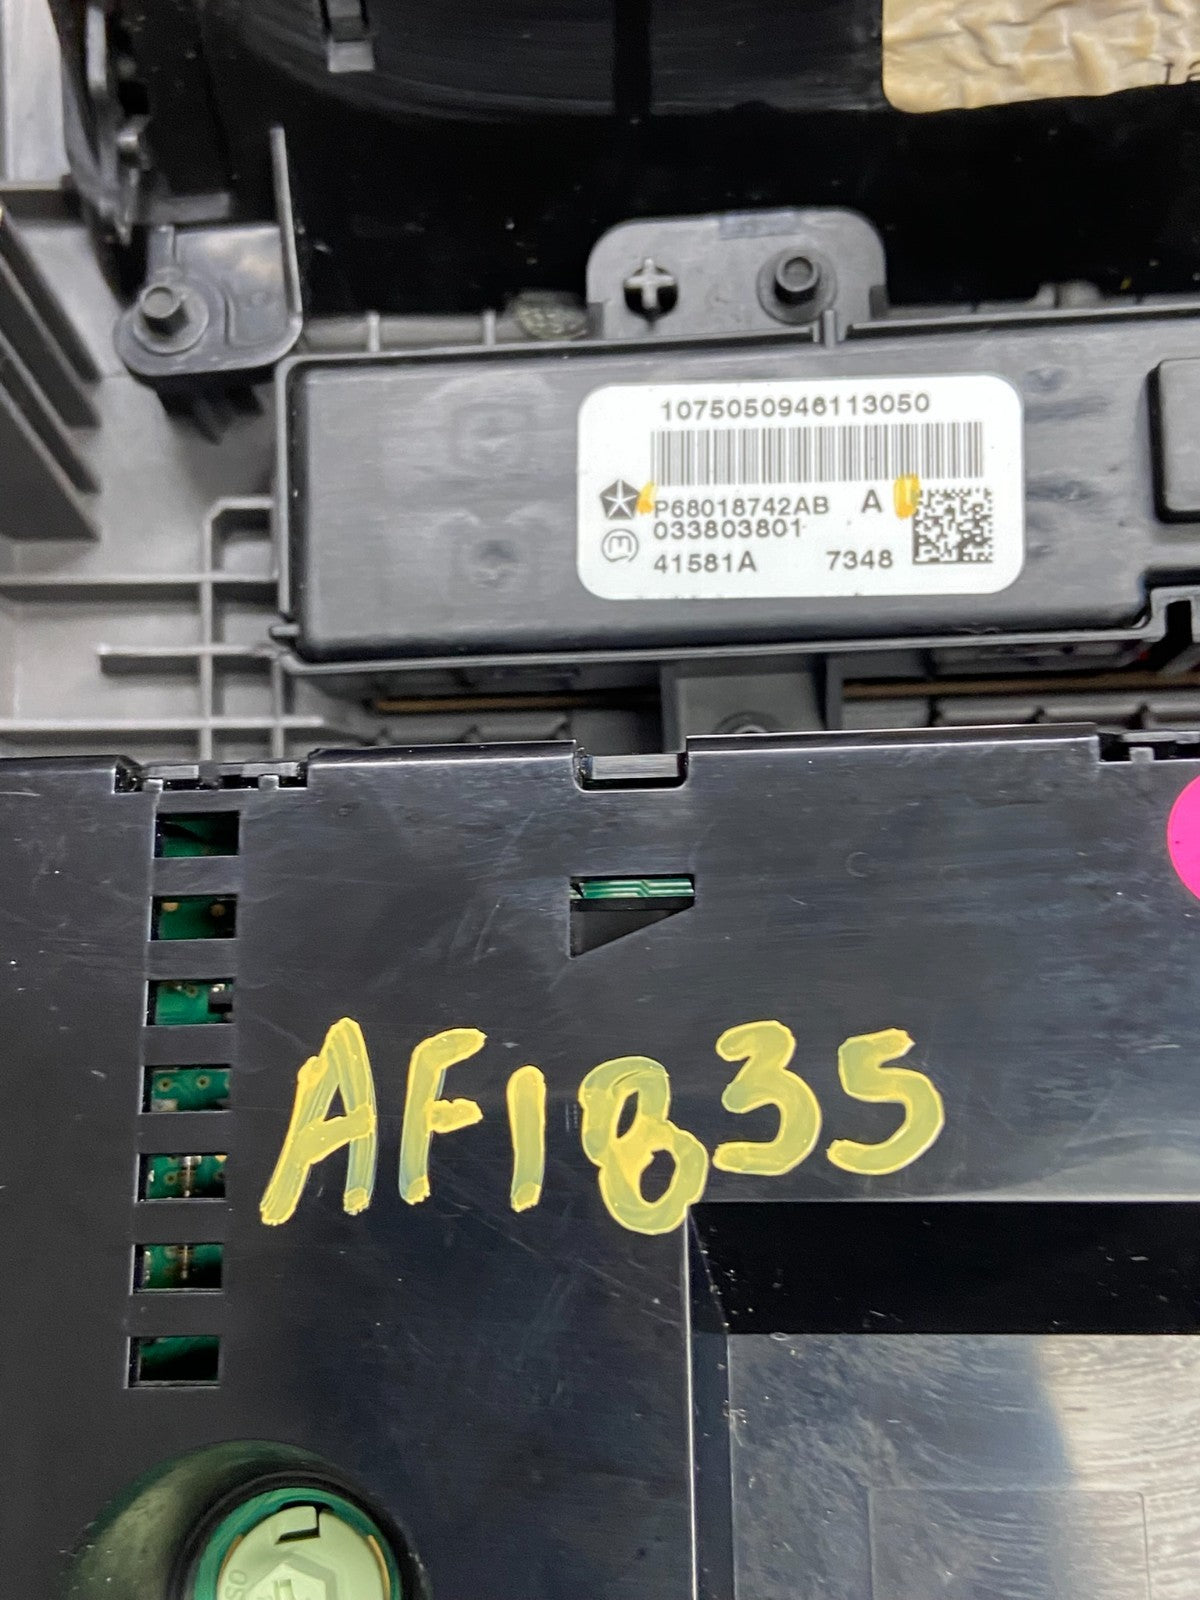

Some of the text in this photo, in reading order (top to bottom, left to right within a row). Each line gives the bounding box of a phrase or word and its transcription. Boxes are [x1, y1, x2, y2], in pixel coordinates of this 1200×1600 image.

[654, 489, 883, 518] P68018742AB A
[653, 518, 802, 540] 033803801
[653, 549, 893, 575] 41581A 7348
